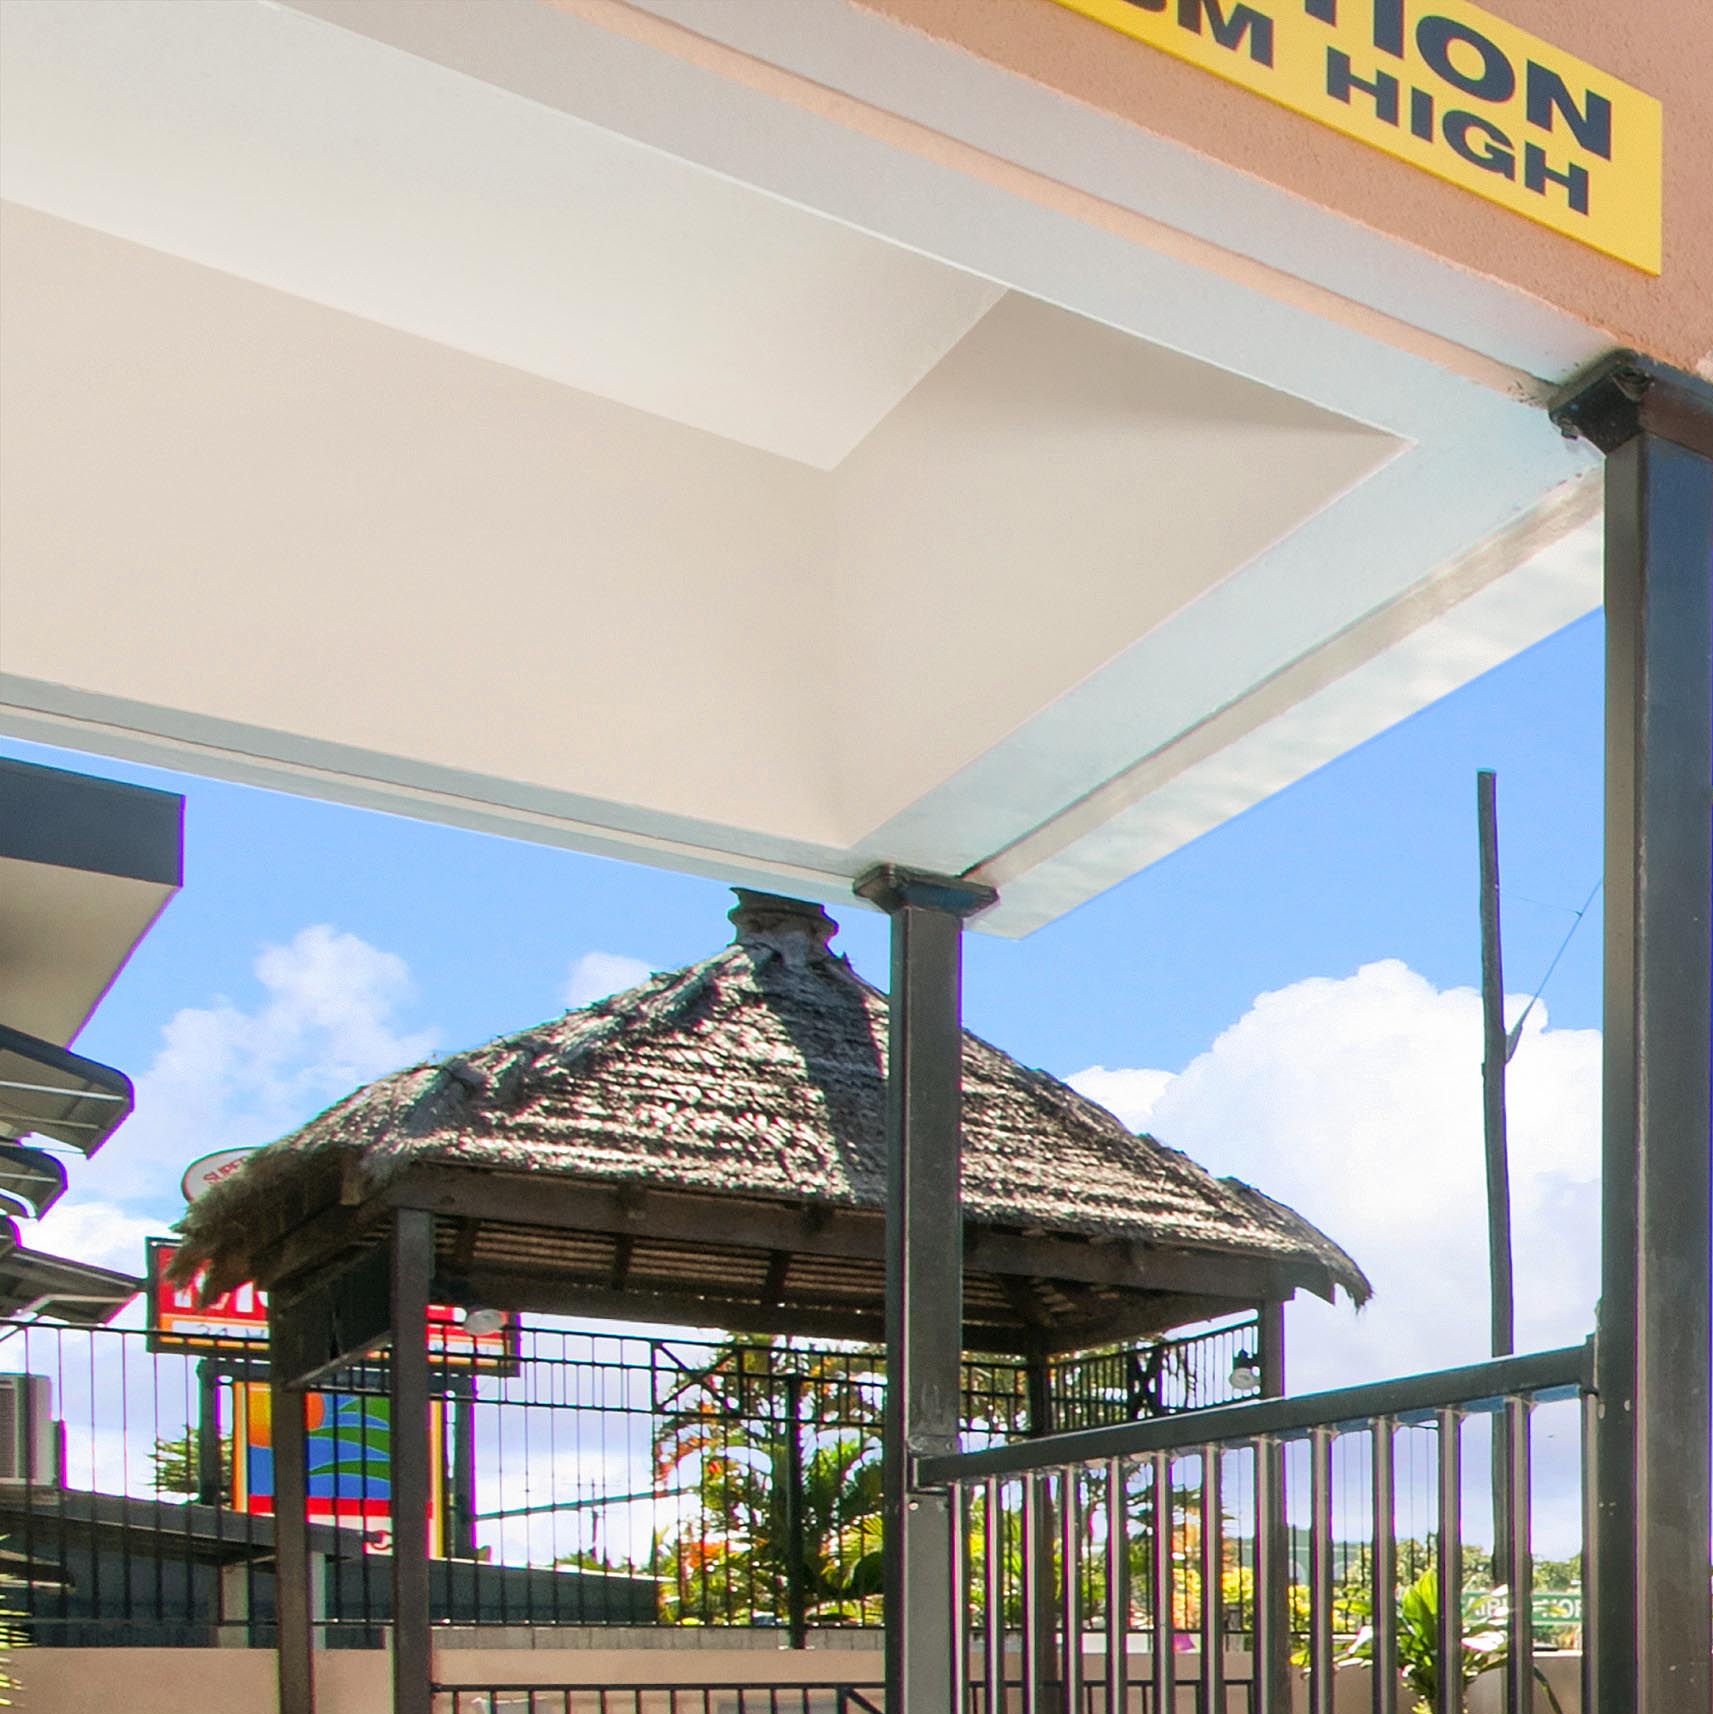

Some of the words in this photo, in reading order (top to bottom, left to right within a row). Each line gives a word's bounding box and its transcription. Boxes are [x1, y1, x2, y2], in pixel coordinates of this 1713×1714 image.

[1121, 0, 1274, 70] M
[1325, 45, 1589, 216] HIGH
[1304, 0, 1612, 161] ION
